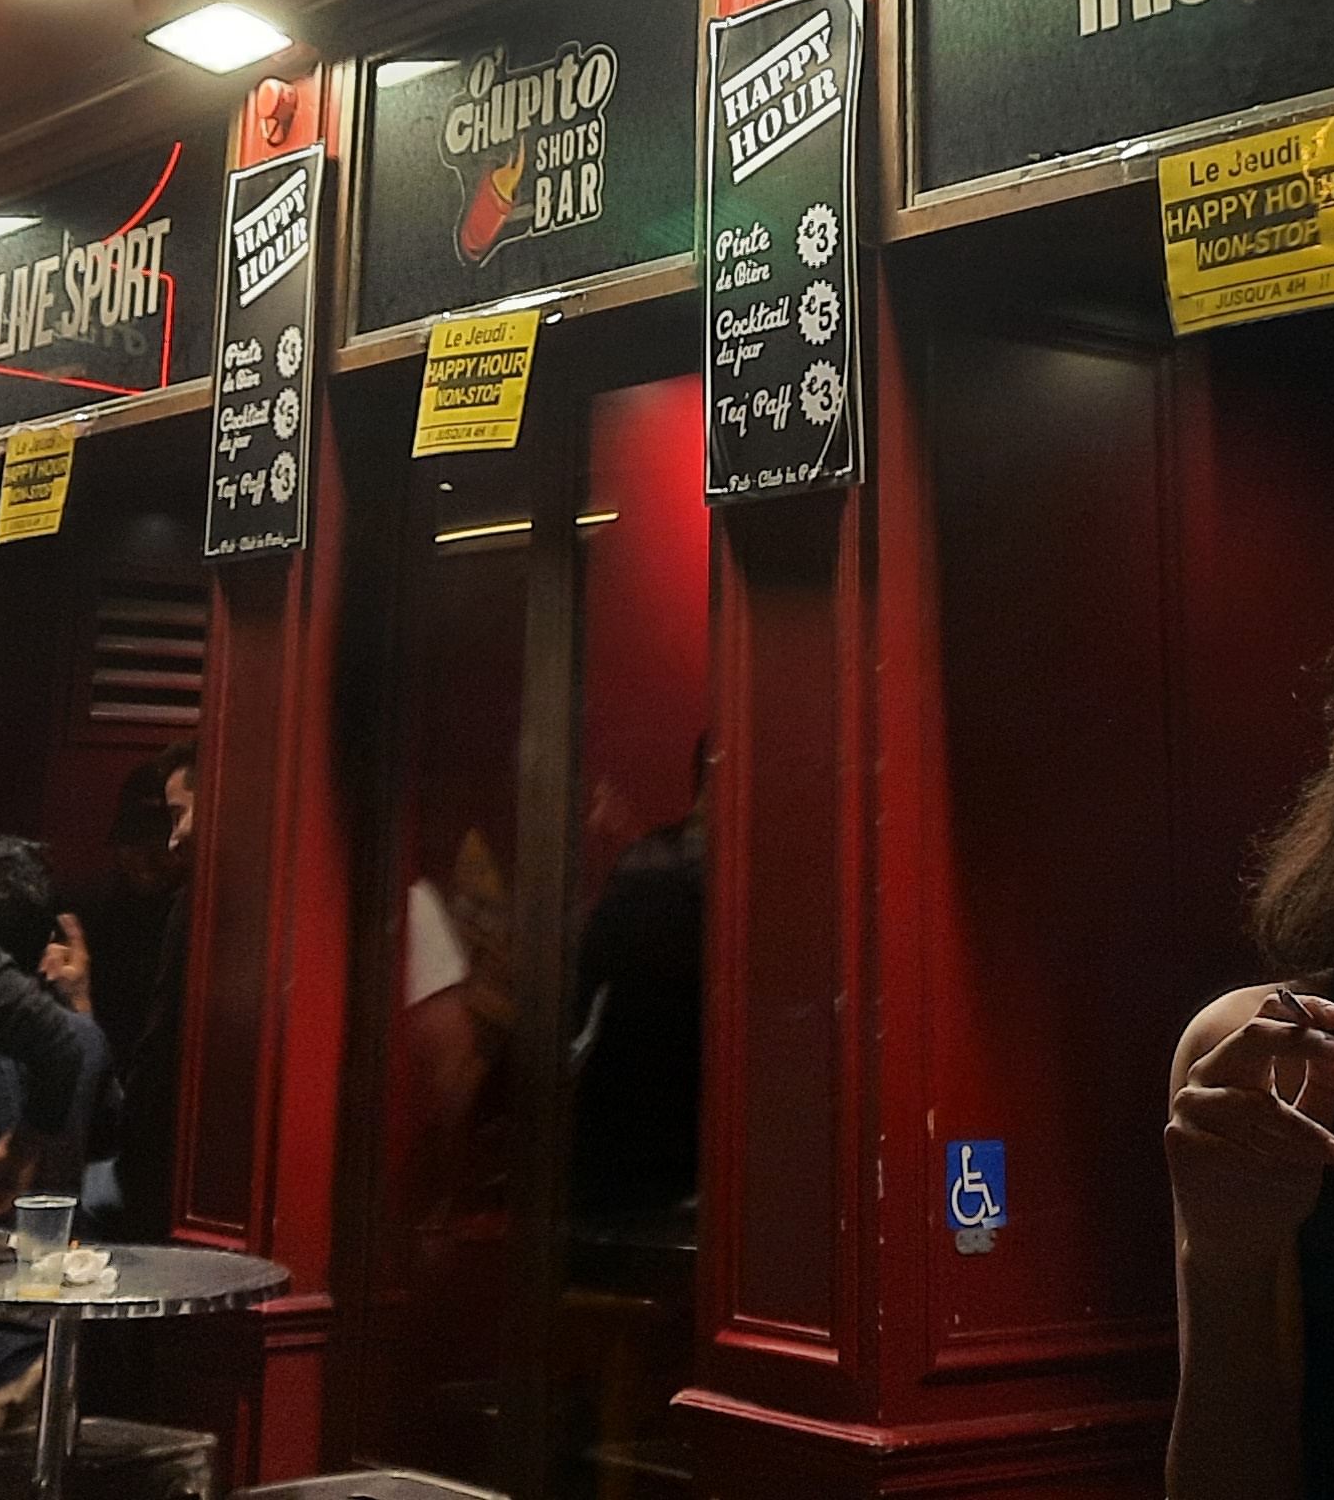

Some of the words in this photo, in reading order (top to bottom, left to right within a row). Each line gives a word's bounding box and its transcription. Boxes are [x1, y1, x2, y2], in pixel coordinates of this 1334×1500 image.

[724, 25, 832, 129] HAPPY
[727, 68, 838, 168] HOUR
[536, 120, 600, 173] SHOTS
[1190, 161, 1220, 187] Le
[1228, 136, 1301, 177] Jeudi
[535, 162, 598, 230] BAR
[1166, 189, 1257, 238] HAPPY
[235, 183, 307, 260] HAPPY
[716, 221, 770, 262] Pinte
[1197, 218, 1320, 265] NON-STOP
[63, 217, 171, 338] SPORT
[237, 216, 308, 293] HOUR
[716, 266, 732, 292] de
[1286, 275, 1307, 295] 4H
[444, 329, 463, 348] Le
[465, 321, 508, 345] Jeudi
[716, 296, 790, 341] Cocktail
[427, 357, 478, 383] HAPPY
[477, 351, 527, 377] HOUR
[716, 341, 735, 366] du
[732, 337, 765, 377] jour
[437, 383, 503, 407] NON-STOP
[753, 383, 793, 430] Paff
